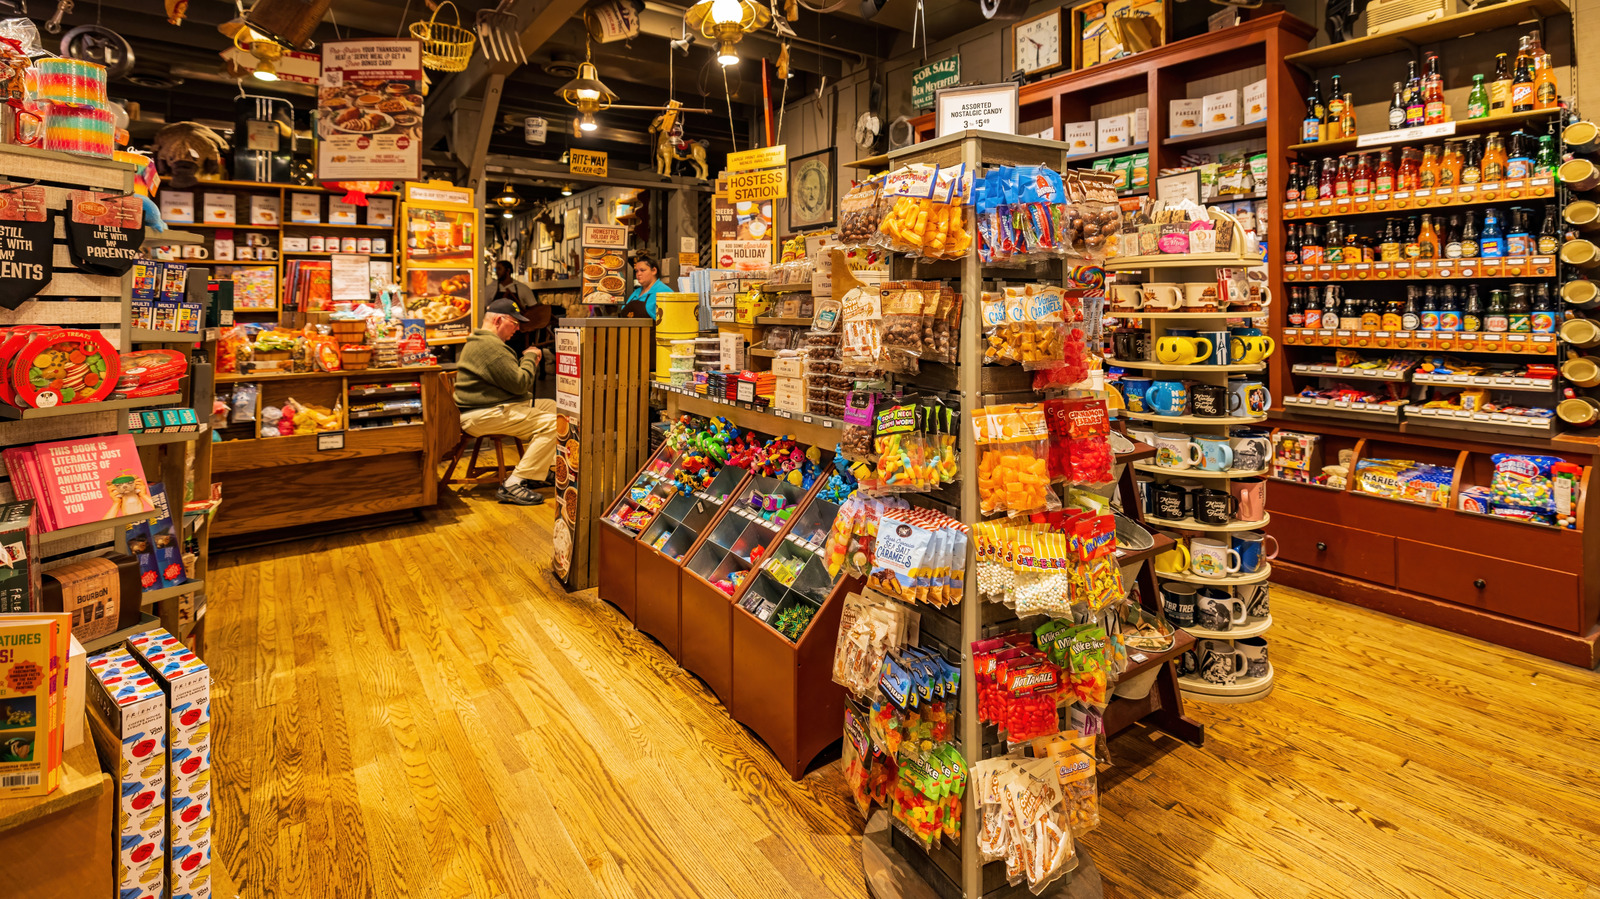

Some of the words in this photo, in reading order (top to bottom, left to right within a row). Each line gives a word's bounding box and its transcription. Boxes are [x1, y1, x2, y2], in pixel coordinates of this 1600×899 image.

[913, 68, 932, 85] FOR
[932, 61, 956, 74] SALE
[912, 85, 924, 96] BEN
[1247, 94, 1265, 103] PANCAKE
[962, 102, 992, 110] ASSORTED
[1207, 103, 1232, 111] PANCAKE
[951, 109, 982, 118] NOSTALGIC
[572, 154, 606, 167] RITE-WAY
[731, 172, 782, 188] HOSTESS
[735, 185, 778, 200] STATION
[94, 231, 108, 239] LIVE
[111, 232, 128, 241] WITH
[7, 238, 32, 251] WITH
[87, 246, 136, 260] PARENTS
[734, 249, 766, 258] HOLIDAY
[0, 262, 43, 280] ENTS
[844, 299, 856, 308] COW
[1034, 294, 1059, 306] Vanilla
[1031, 301, 1062, 320] CARAMELS
[46, 332, 66, 341] DOG
[66, 331, 91, 340] TREATS
[881, 412, 894, 422] SOUR
[1069, 409, 1104, 419] CINNAMON
[1076, 418, 1101, 426] BEARS
[49, 447, 70, 456] THIS
[72, 444, 96, 454] BOOK
[52, 452, 98, 466] LITERALLY
[100, 450, 122, 459] JUST
[54, 463, 98, 475] PICTURES
[100, 460, 110, 468] OF
[57, 472, 100, 485] ANIMALS
[60, 481, 100, 494] SILENTLY
[63, 491, 103, 504] JUDGING
[65, 504, 84, 514] YOU
[884, 541, 896, 549] SEA
[895, 545, 911, 555] SALT
[876, 546, 912, 568] CARAMELS
[77, 588, 108, 604] BOURBON
[1165, 600, 1177, 611] TAR
[1179, 604, 1195, 613] TREK
[1041, 632, 1060, 644] Mike
[174, 676, 208, 691] FRIENDS
[1012, 676, 1026, 689] HOT
[1027, 673, 1052, 685] TAMALE
[125, 703, 163, 720] FRIENDS
[925, 762, 939, 780] Ike
